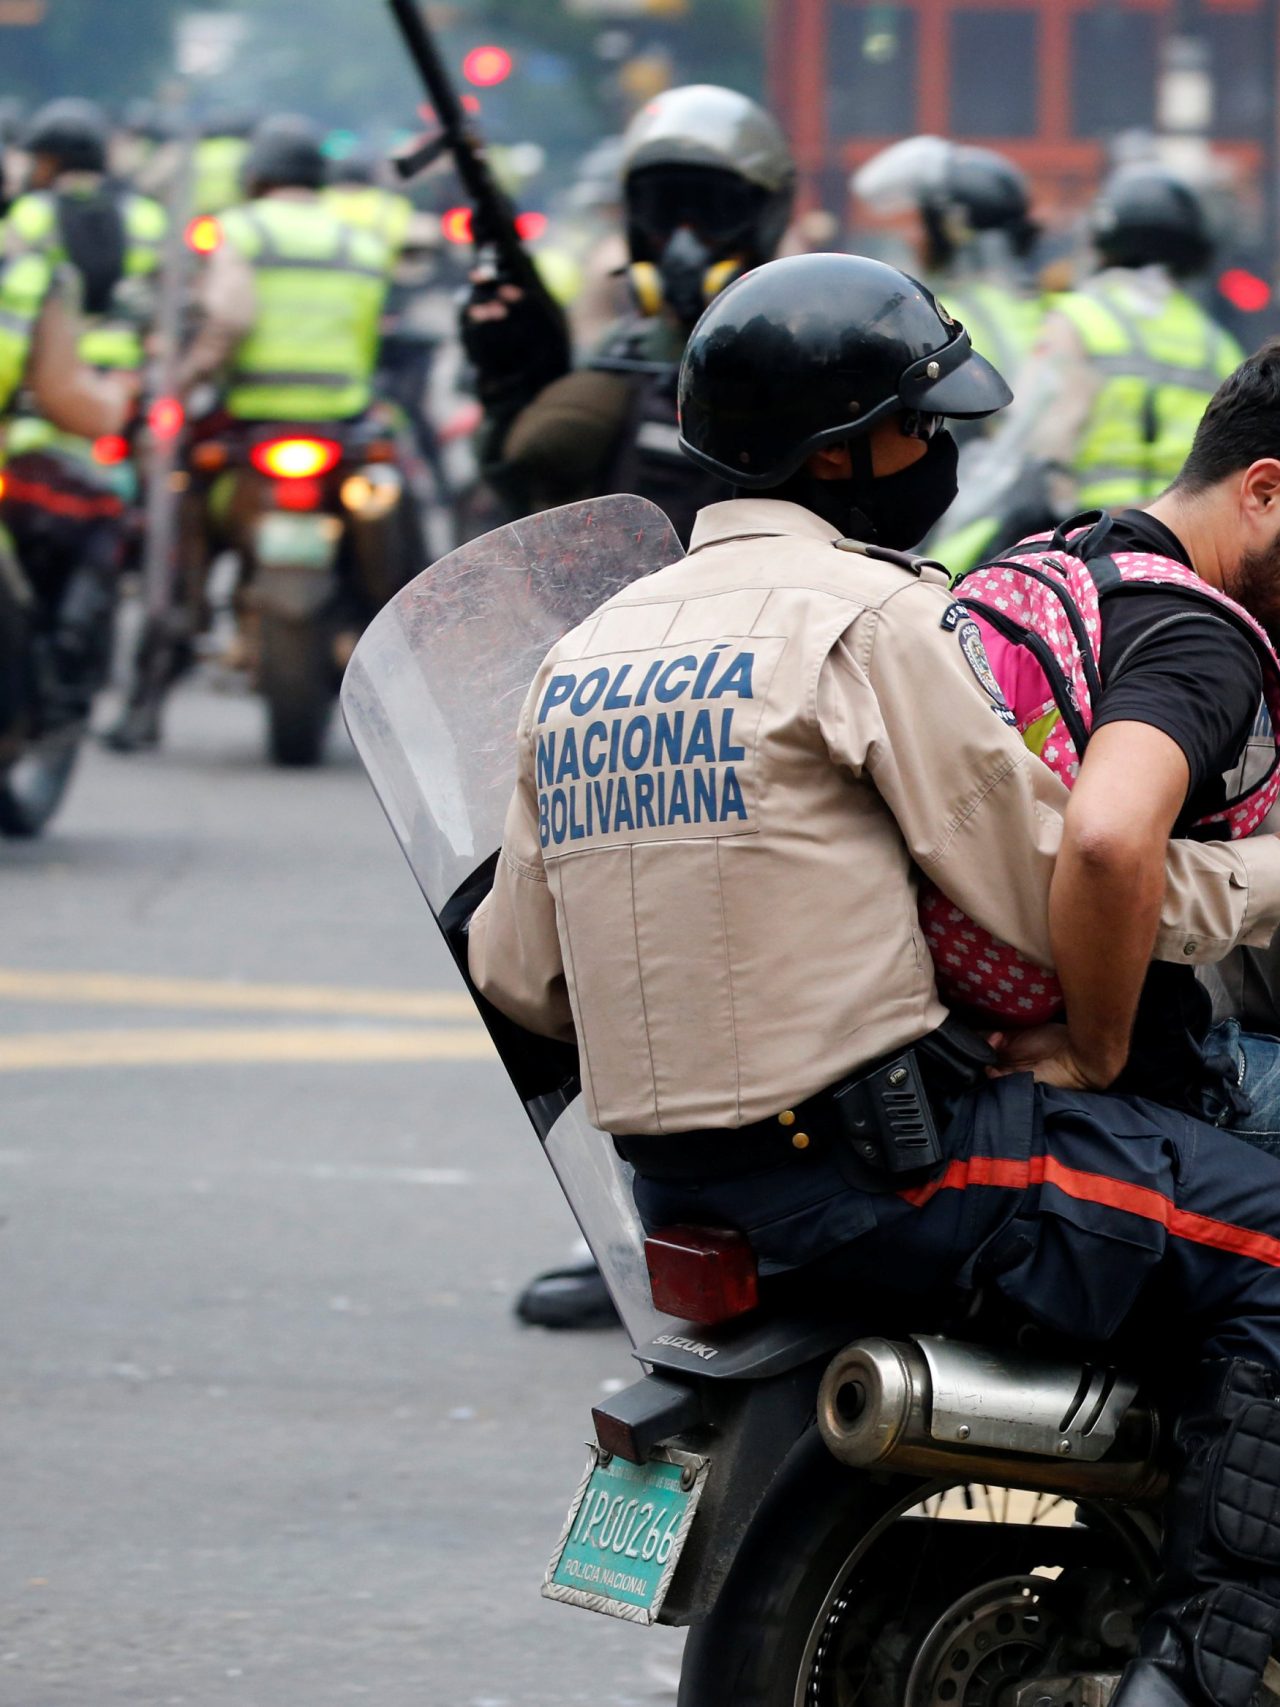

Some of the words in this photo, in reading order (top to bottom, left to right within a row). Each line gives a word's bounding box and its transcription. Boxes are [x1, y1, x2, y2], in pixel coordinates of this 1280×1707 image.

[537, 644, 755, 725] POLICÍA
[537, 708, 746, 789] NACIONAL
[538, 767, 749, 849] BOLIVARIANA
[652, 1335, 719, 1361] SUZUKI
[573, 1489, 682, 1565] 1P00266
[565, 1559, 600, 1583] POLICIA
[600, 1568, 648, 1597] NACIONAL
